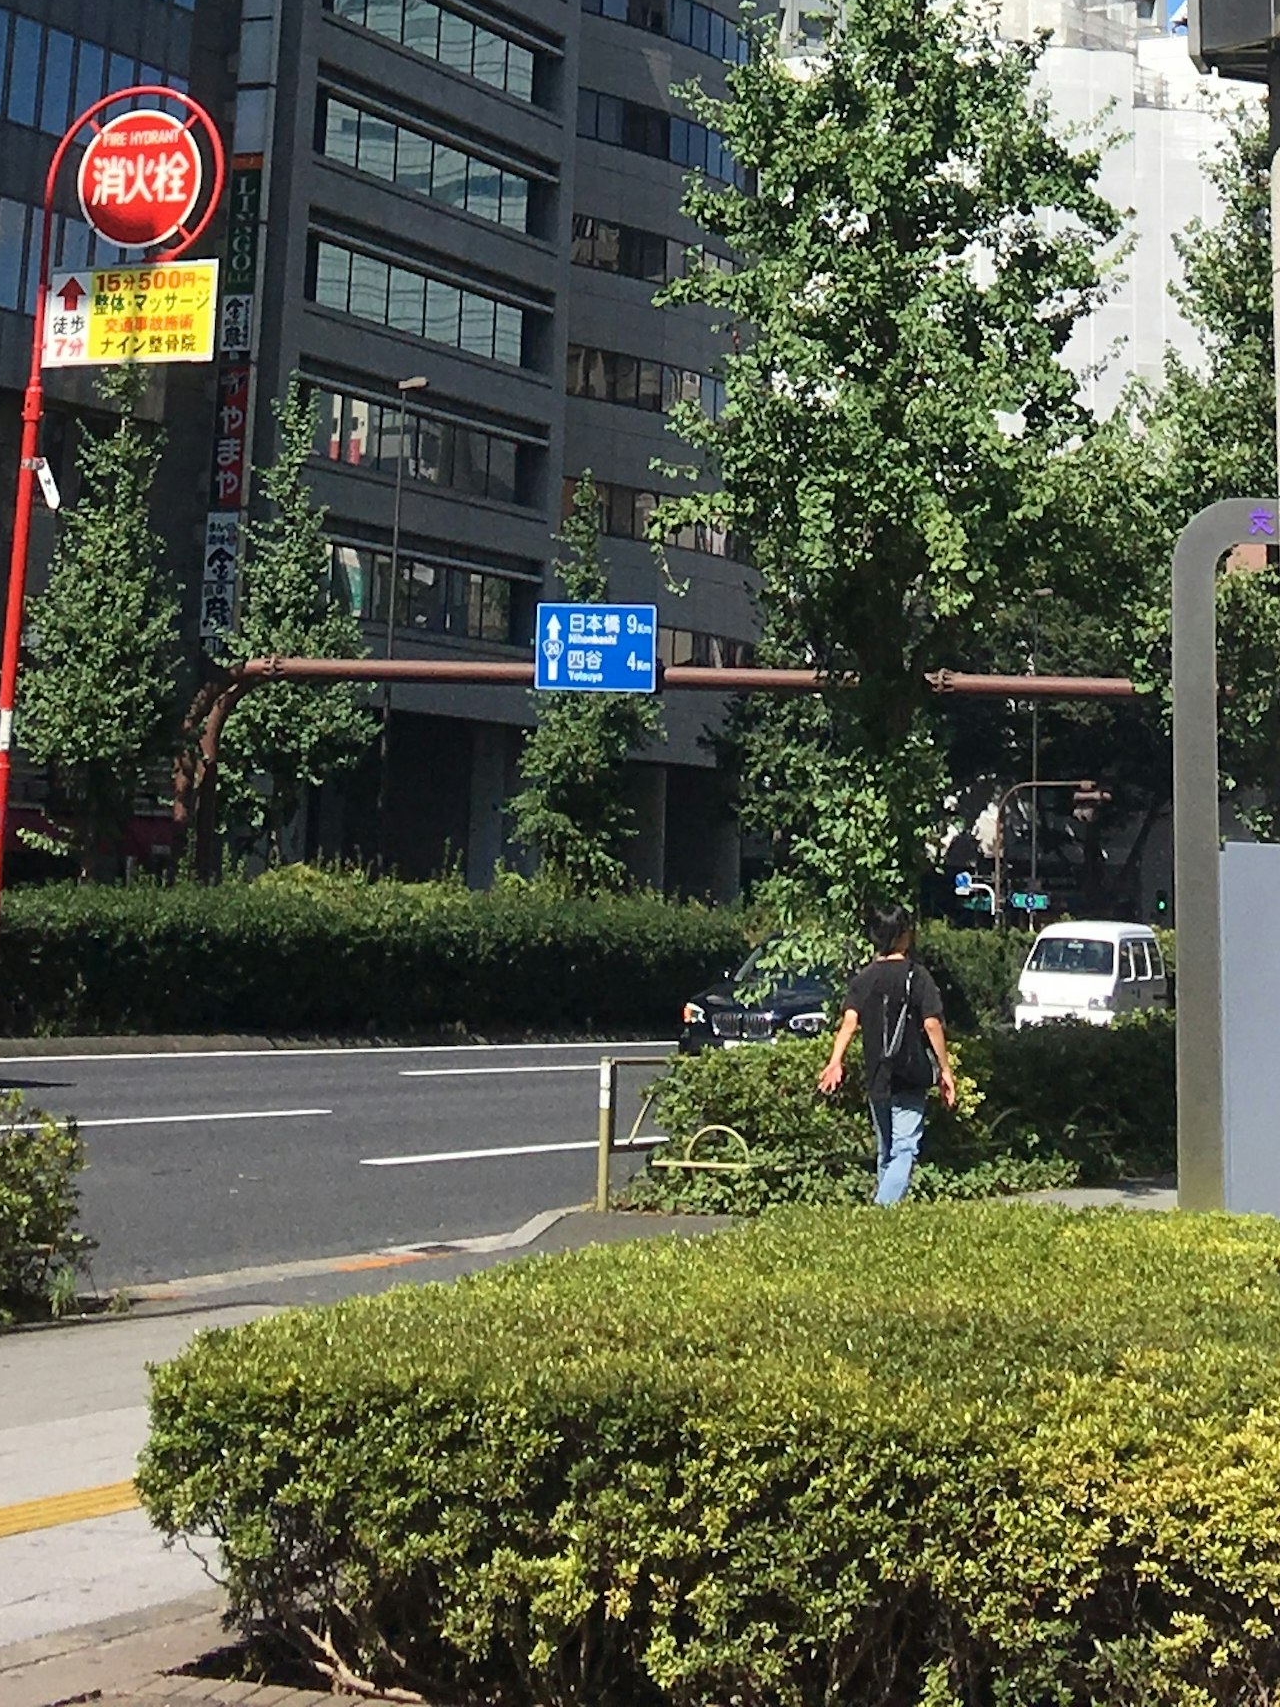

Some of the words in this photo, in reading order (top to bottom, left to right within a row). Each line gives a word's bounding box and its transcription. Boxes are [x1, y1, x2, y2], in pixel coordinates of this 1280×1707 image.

[102, 132, 127, 147] FIRE
[130, 130, 180, 146] HYDRANT
[91, 150, 190, 206] 消火栓
[53, 315, 85, 335] 徒歩
[105, 313, 194, 333] 交通事故施術
[54, 337, 84, 358] 7分
[100, 334, 196, 355] ナイン整骨院
[215, 405, 244, 499] やまや
[1249, 506, 1275, 536] 文
[569, 613, 620, 634] 日本橋
[567, 650, 603, 670] 四谷
